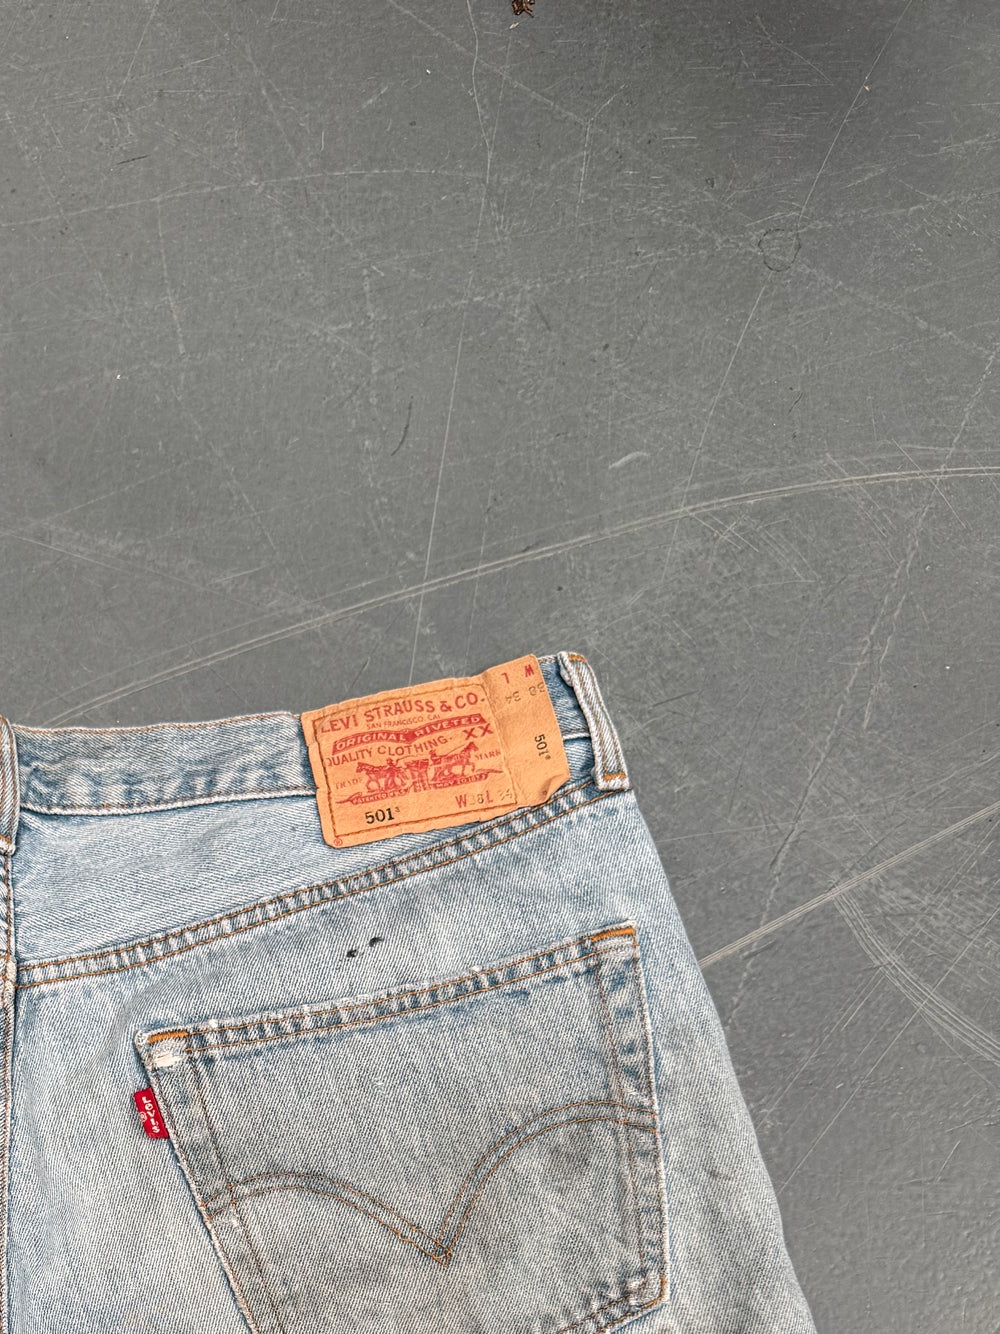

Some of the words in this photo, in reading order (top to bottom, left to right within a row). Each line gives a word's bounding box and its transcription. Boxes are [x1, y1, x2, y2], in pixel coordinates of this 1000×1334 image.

[321, 714, 358, 733] LEVI
[364, 700, 435, 722] STRAUSS
[440, 701, 452, 712] &
[336, 731, 407, 751] ORIGINAL
[413, 715, 482, 738] RIVETED
[366, 722, 382, 731] SAN
